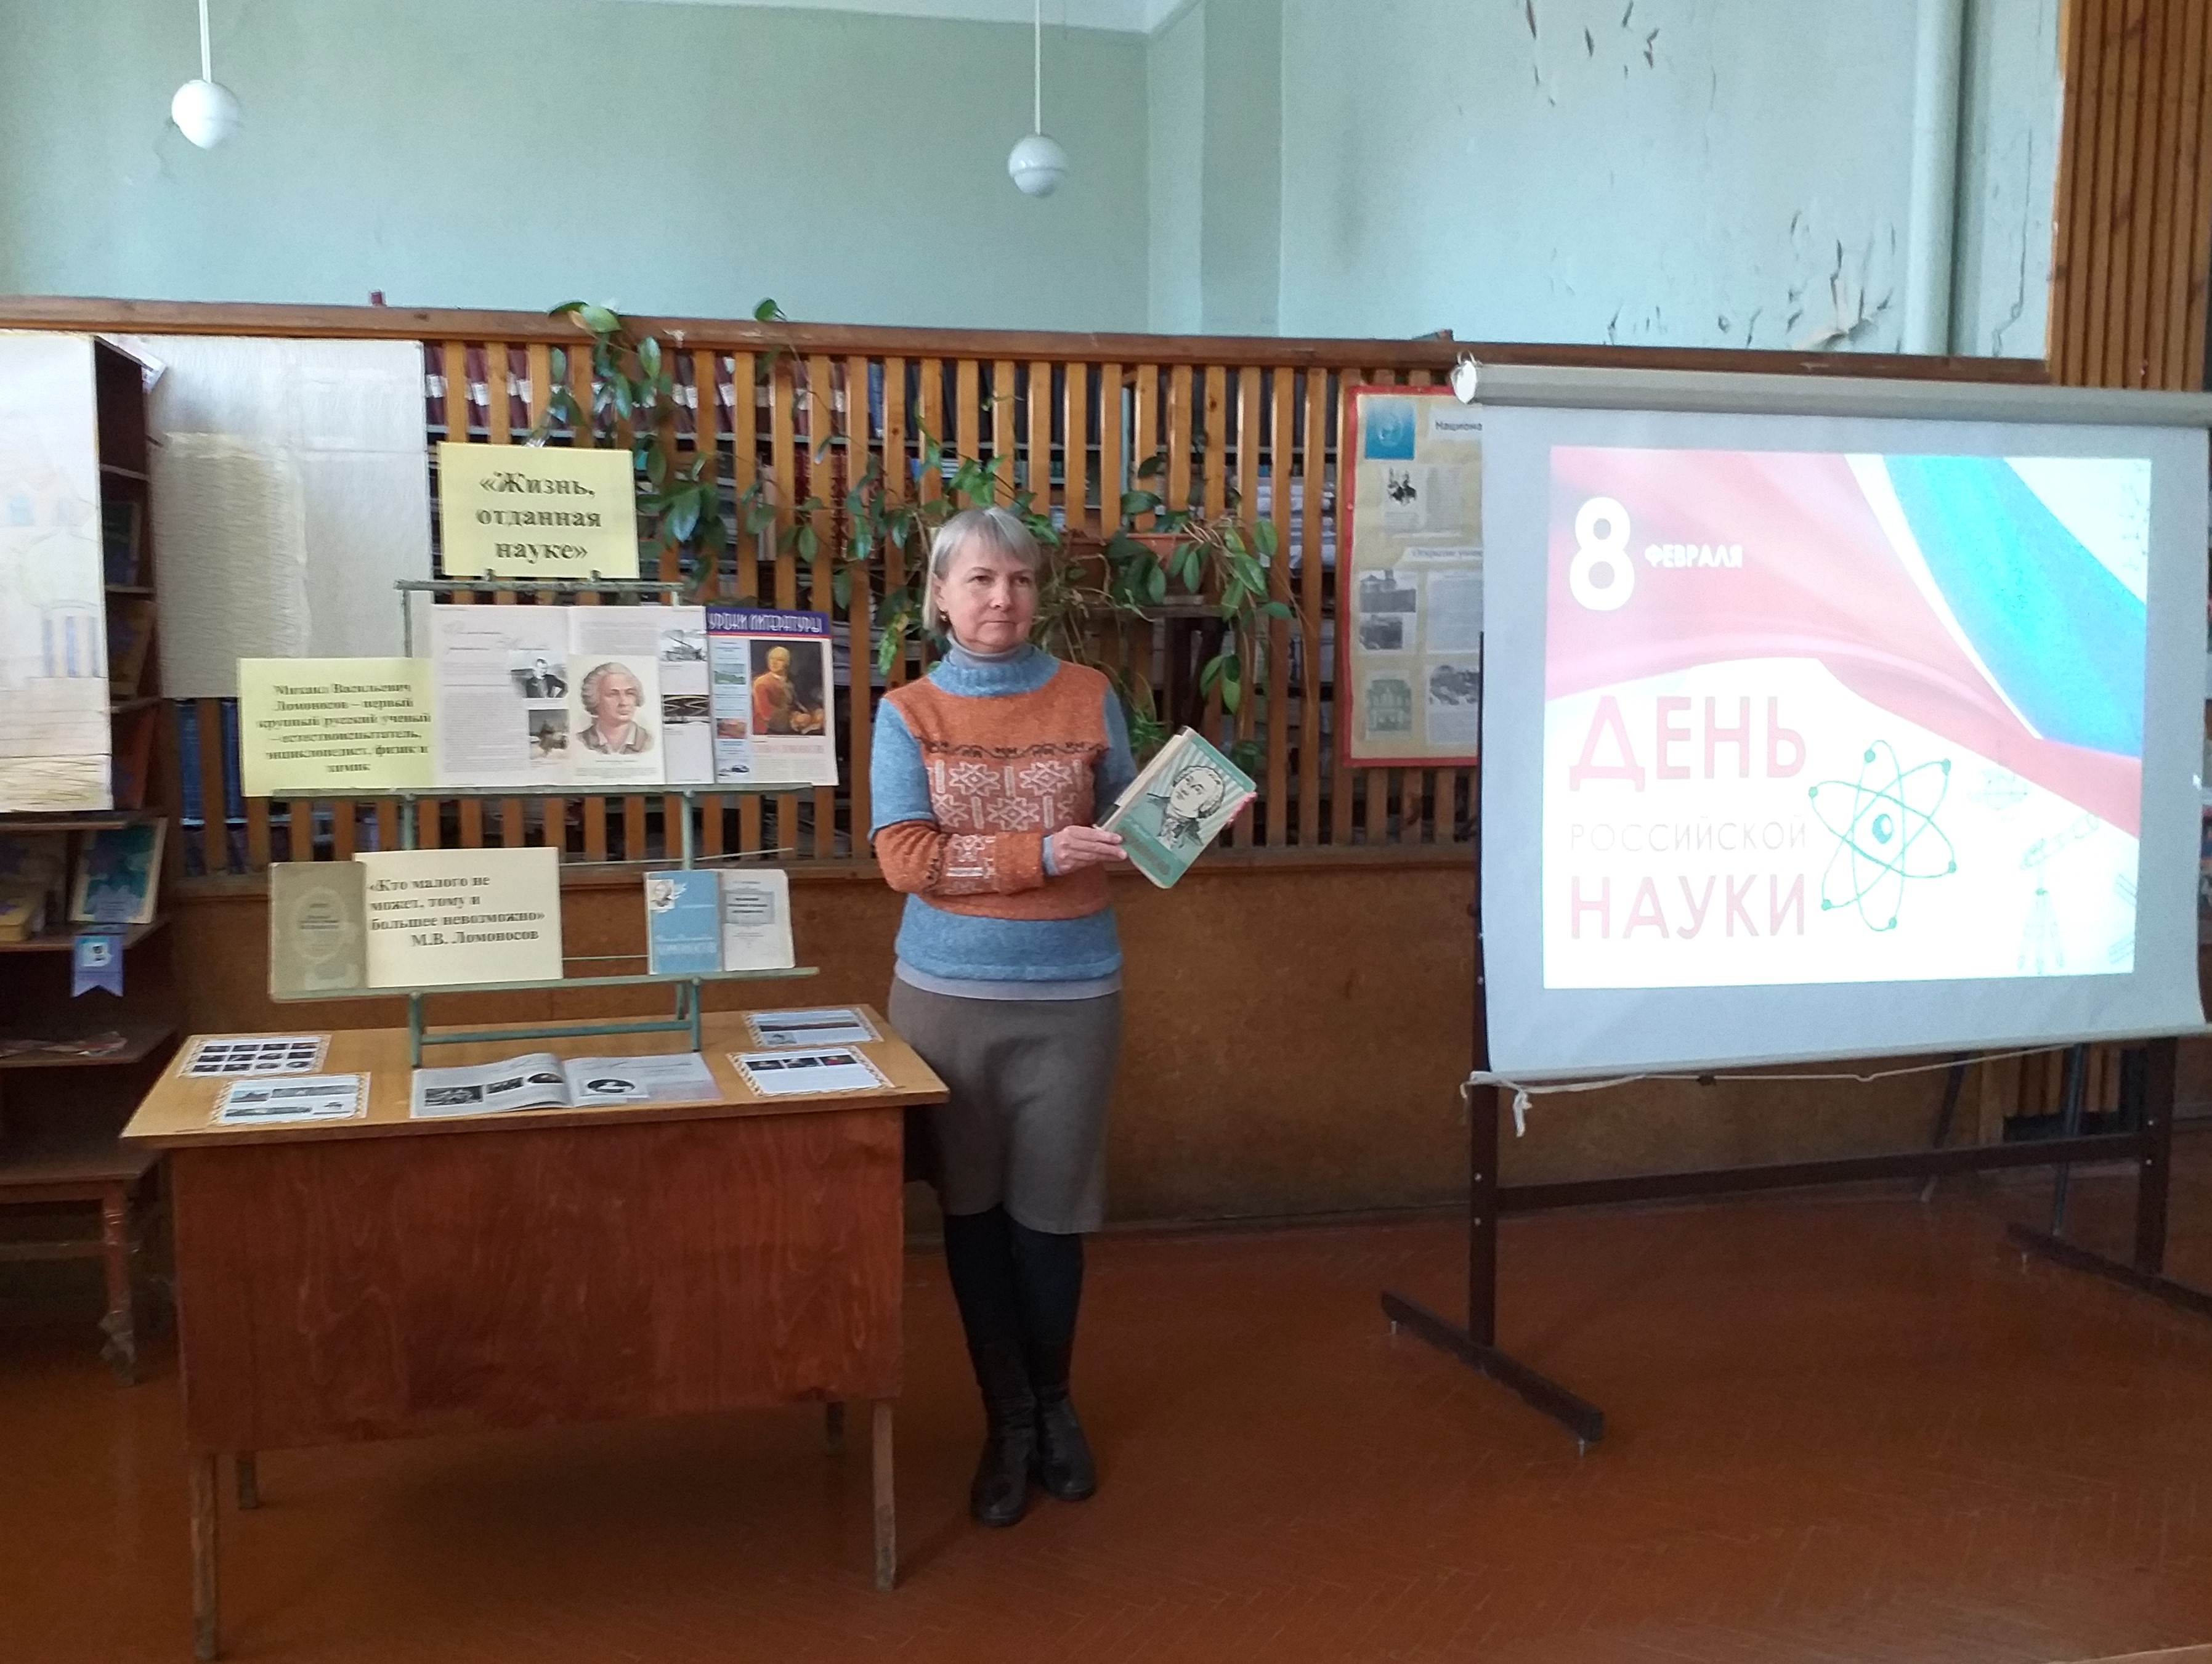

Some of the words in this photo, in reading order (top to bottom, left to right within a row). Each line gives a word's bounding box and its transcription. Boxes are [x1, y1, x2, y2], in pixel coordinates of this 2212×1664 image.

[479, 471, 595, 498] «Жизнь,
[476, 509, 601, 527] отданная
[494, 543, 588, 564] науке»
[1570, 497, 1635, 611] 8
[1644, 543, 1743, 568] ФЕВРАЛЯ
[273, 700, 349, 711] Ломоносов
[1569, 695, 1807, 792] ДЕНЬ
[1571, 816, 1806, 853] РОССИЙСКОЙ
[411, 877, 468, 889] малого
[472, 877, 490, 886] не
[427, 897, 464, 909] тому
[1571, 873, 1806, 940] НАУКИ
[371, 918, 438, 931] большее
[442, 912, 546, 926] невозможно»
[410, 932, 449, 947] М.В.
[451, 931, 540, 944] Ломоносов
